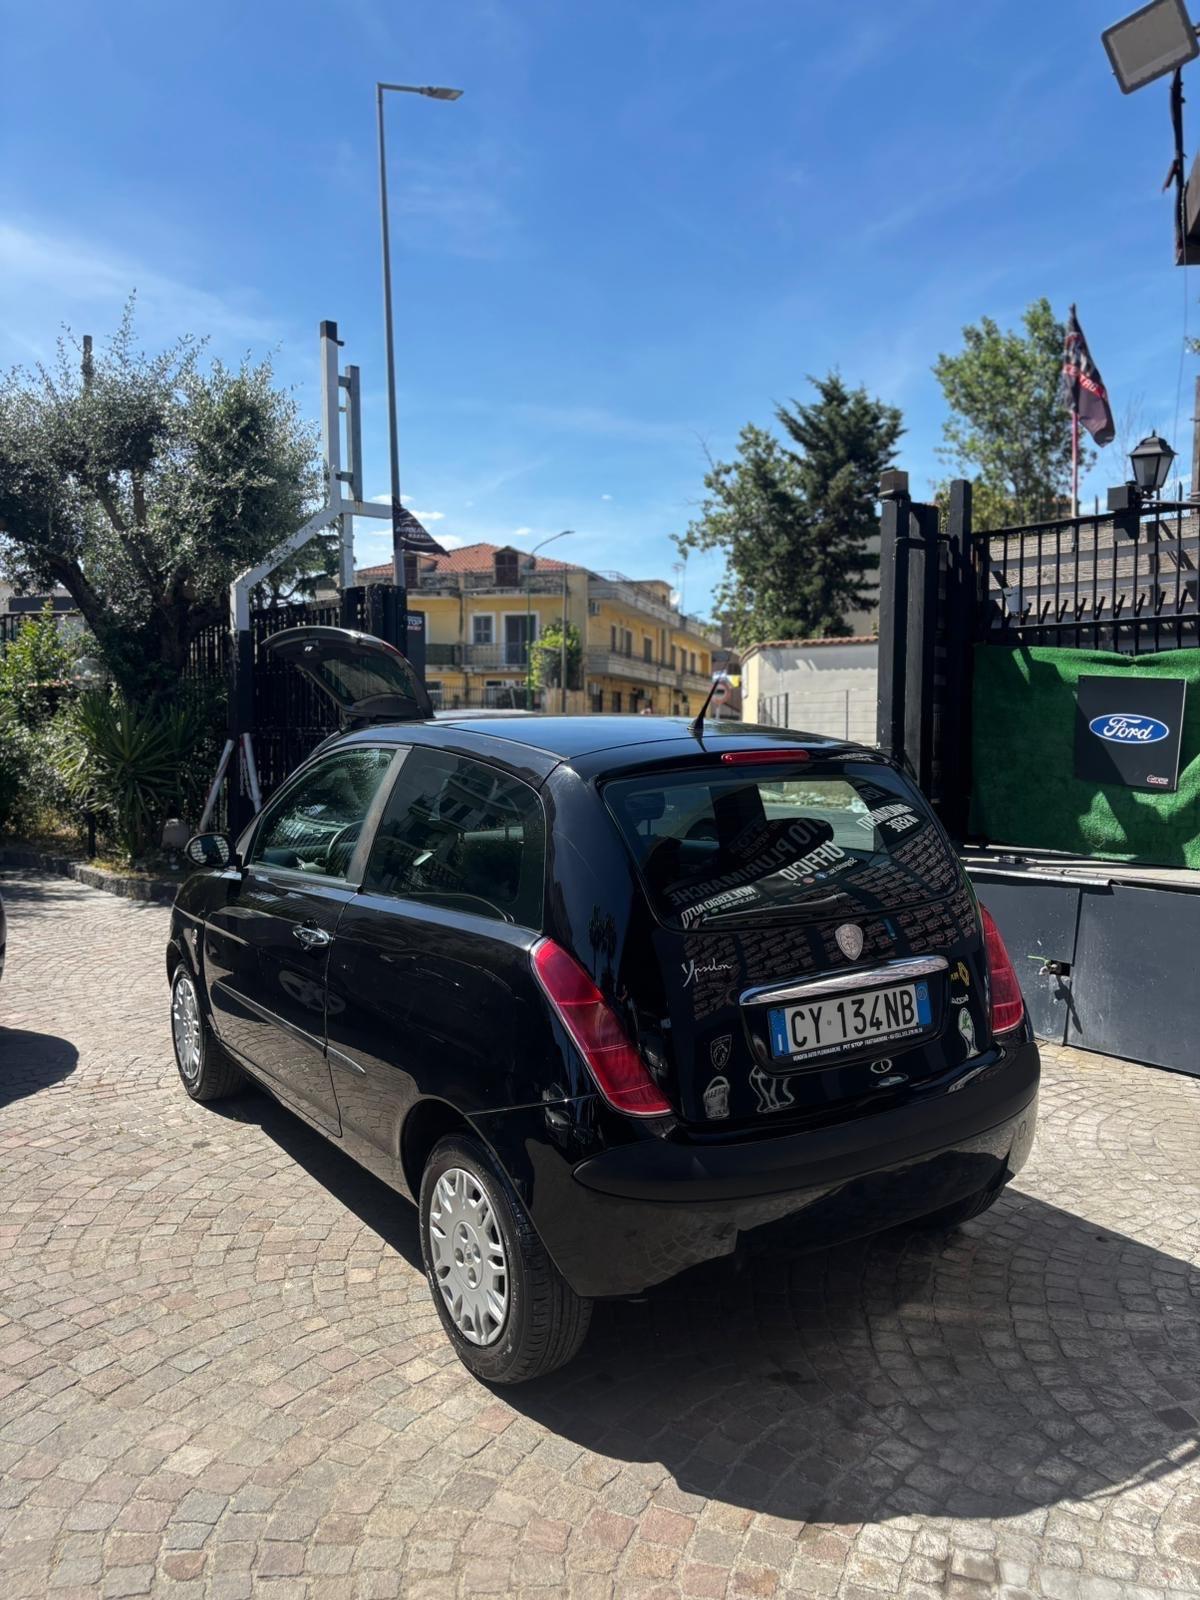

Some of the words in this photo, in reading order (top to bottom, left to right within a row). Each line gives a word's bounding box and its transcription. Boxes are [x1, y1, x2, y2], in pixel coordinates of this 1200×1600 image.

[1103, 716, 1154, 740] Ford
[681, 957, 732, 988] Ypsilon
[791, 1006, 822, 1048] CY
[837, 989, 915, 1038] 134NB
[850, 1040, 863, 1049] STOP
